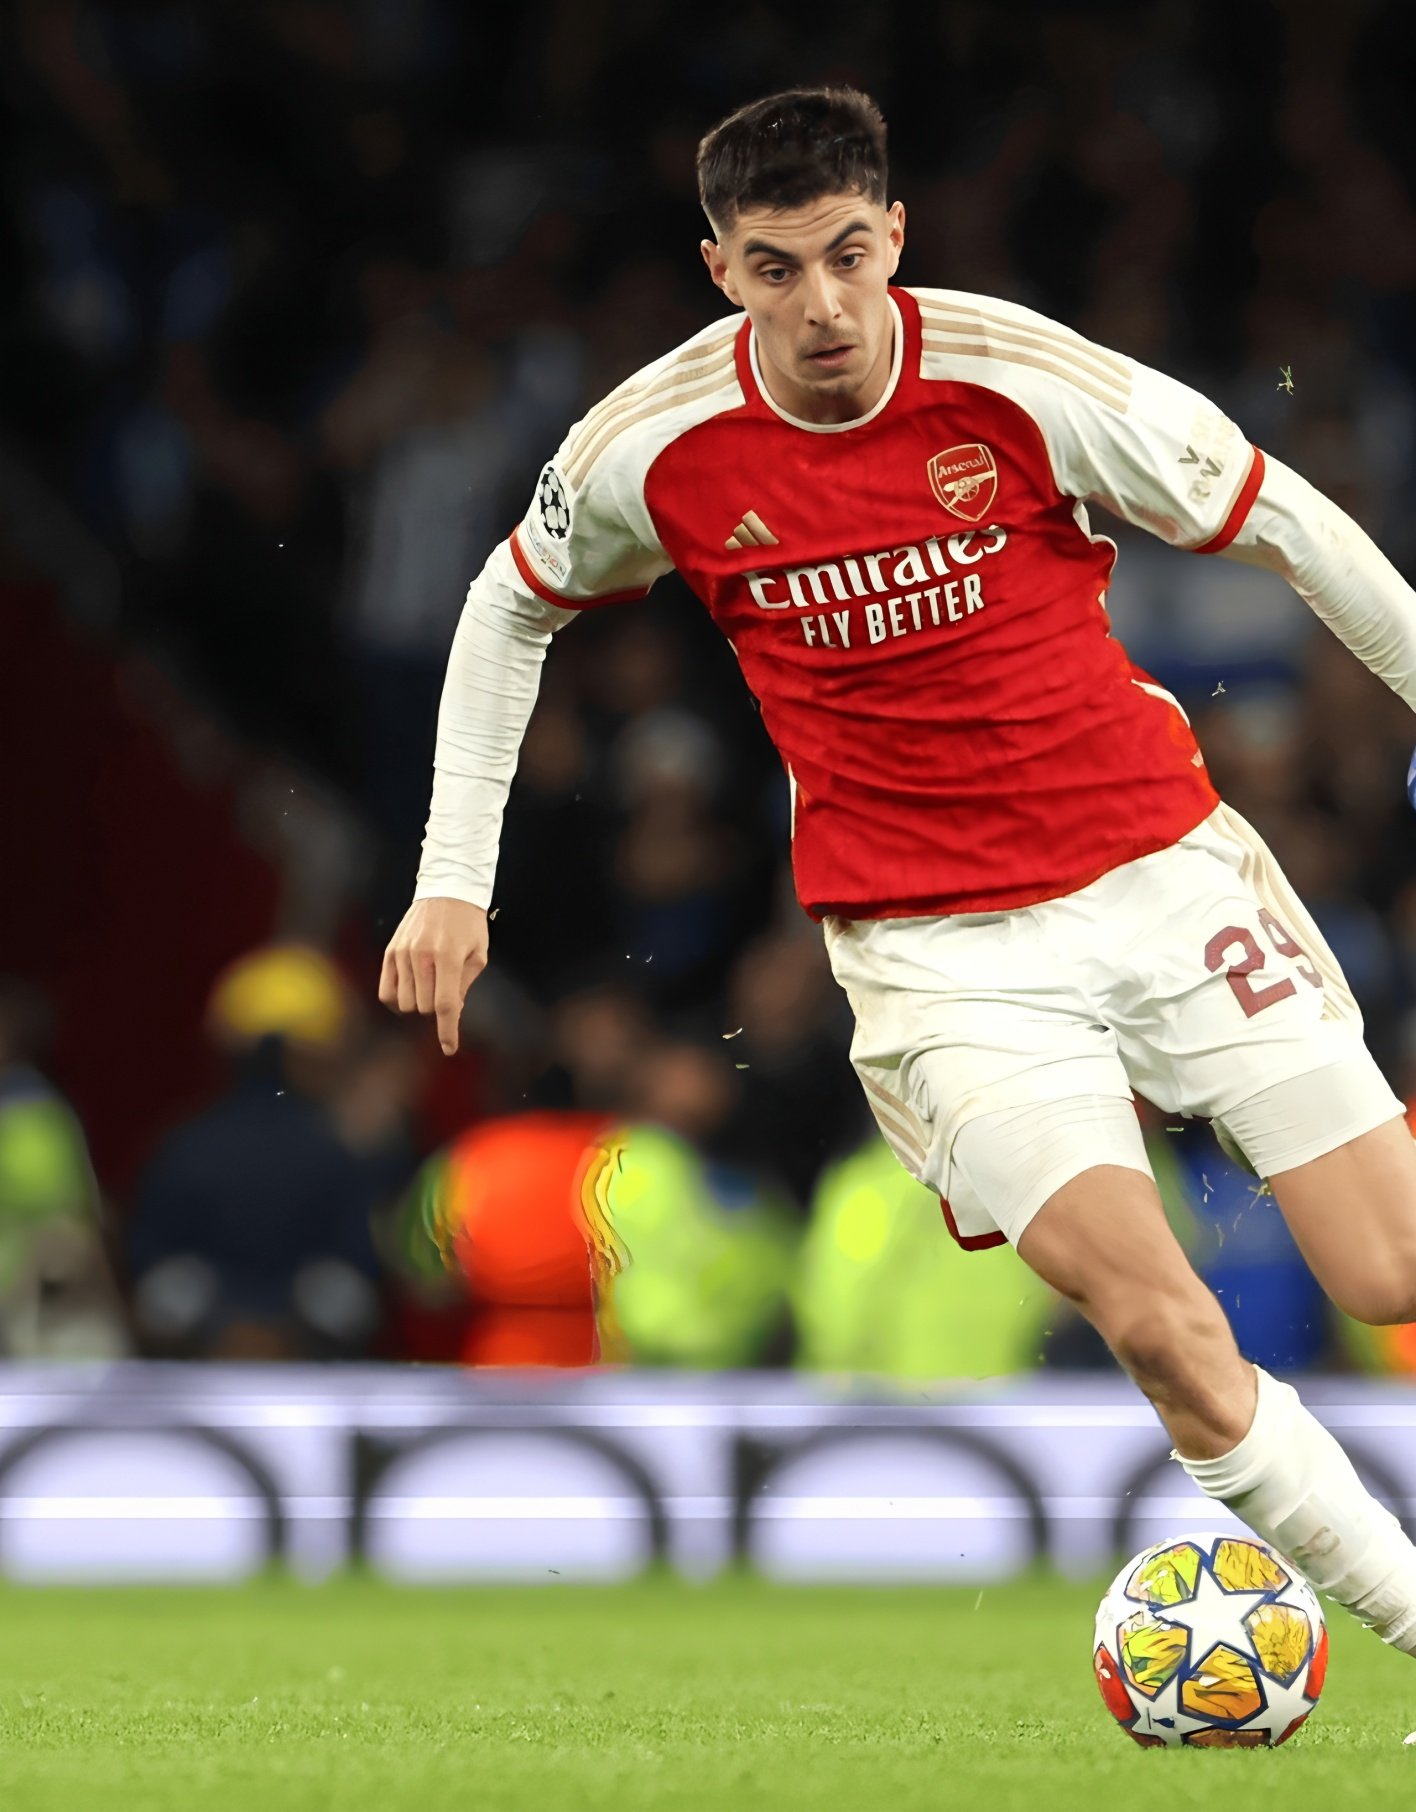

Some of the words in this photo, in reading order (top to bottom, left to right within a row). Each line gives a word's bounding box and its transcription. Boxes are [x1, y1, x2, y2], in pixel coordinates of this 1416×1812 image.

[938, 455, 984, 478] Arsenal
[742, 524, 1007, 610] Emirates
[800, 609, 851, 649] FLY
[864, 573, 985, 645] BETTER
[1204, 907, 1324, 1019] 29
